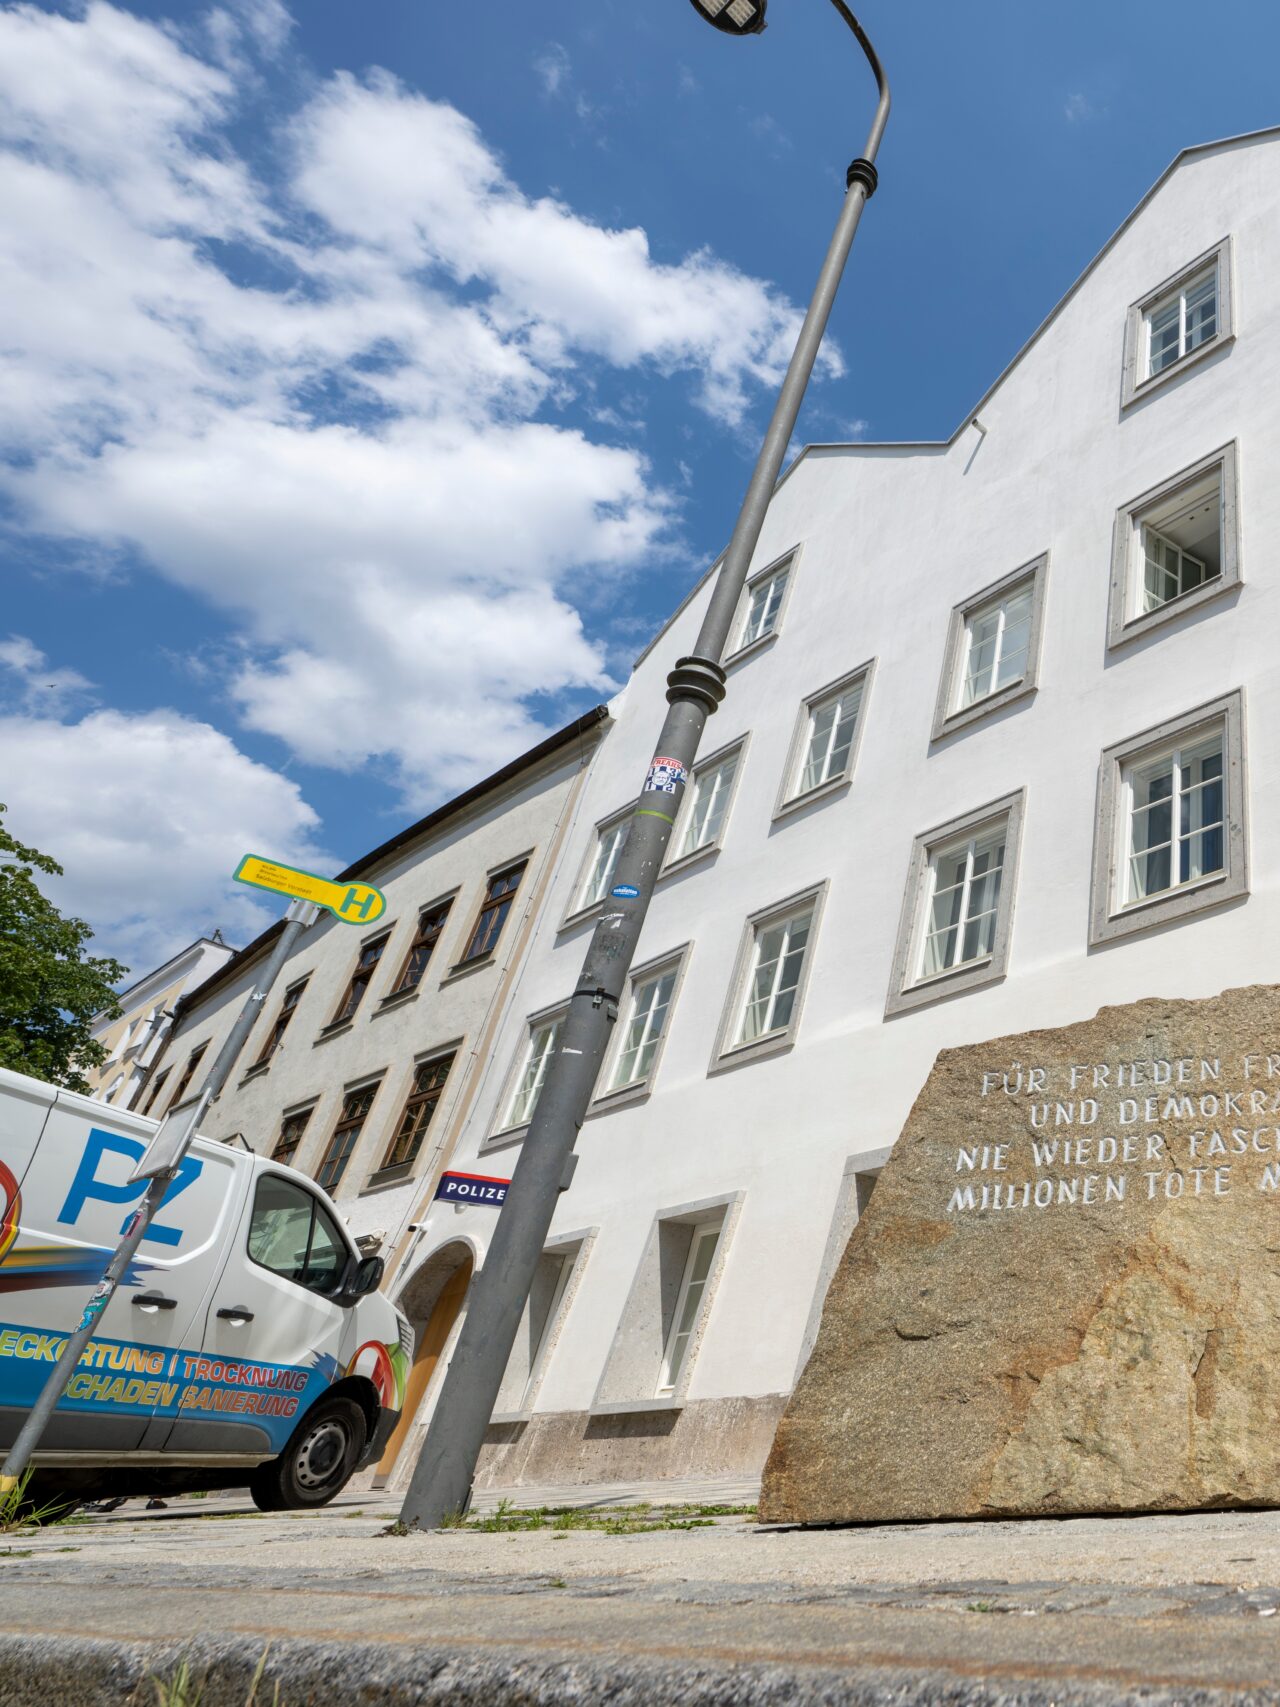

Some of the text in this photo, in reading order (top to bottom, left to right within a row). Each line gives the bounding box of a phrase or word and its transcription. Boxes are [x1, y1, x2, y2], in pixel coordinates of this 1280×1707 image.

[339, 888, 376, 919] H
[982, 1062, 1048, 1097] FÜR
[1070, 1056, 1222, 1092] FRIEDEN
[1030, 1098, 1100, 1129] UND
[955, 1143, 1009, 1173] NIE
[1033, 1132, 1164, 1168] WIEDER
[447, 1183, 506, 1200] POLIZE
[947, 1174, 1126, 1212] MILLIONEN
[1145, 1165, 1232, 1200] TOTE
[183, 1356, 309, 1391] TROCKNUNG
[60, 1373, 299, 1417] CHADEN SANIERUNG
